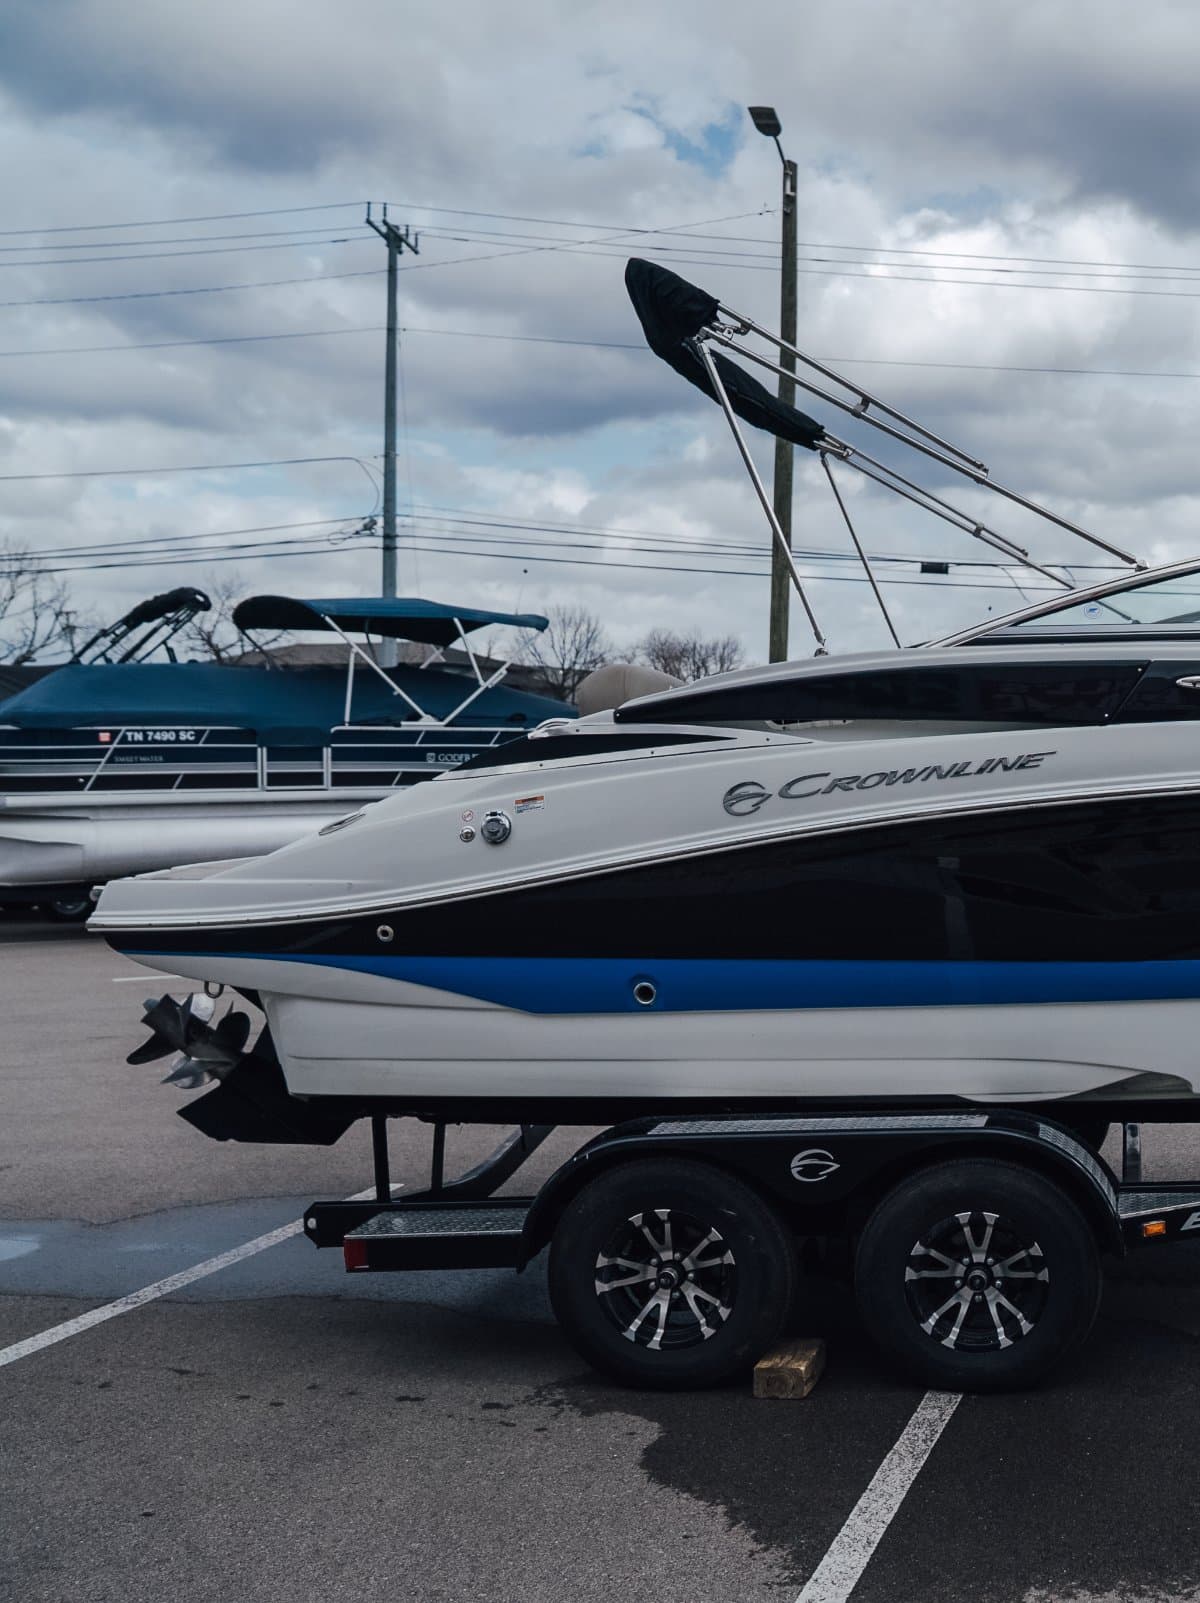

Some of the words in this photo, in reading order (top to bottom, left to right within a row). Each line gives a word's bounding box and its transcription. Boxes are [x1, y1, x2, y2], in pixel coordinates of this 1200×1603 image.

[126, 732, 144, 741] TN
[147, 731, 176, 741] 7490
[179, 731, 196, 740] SC
[777, 751, 1056, 799] CROWNLINE
